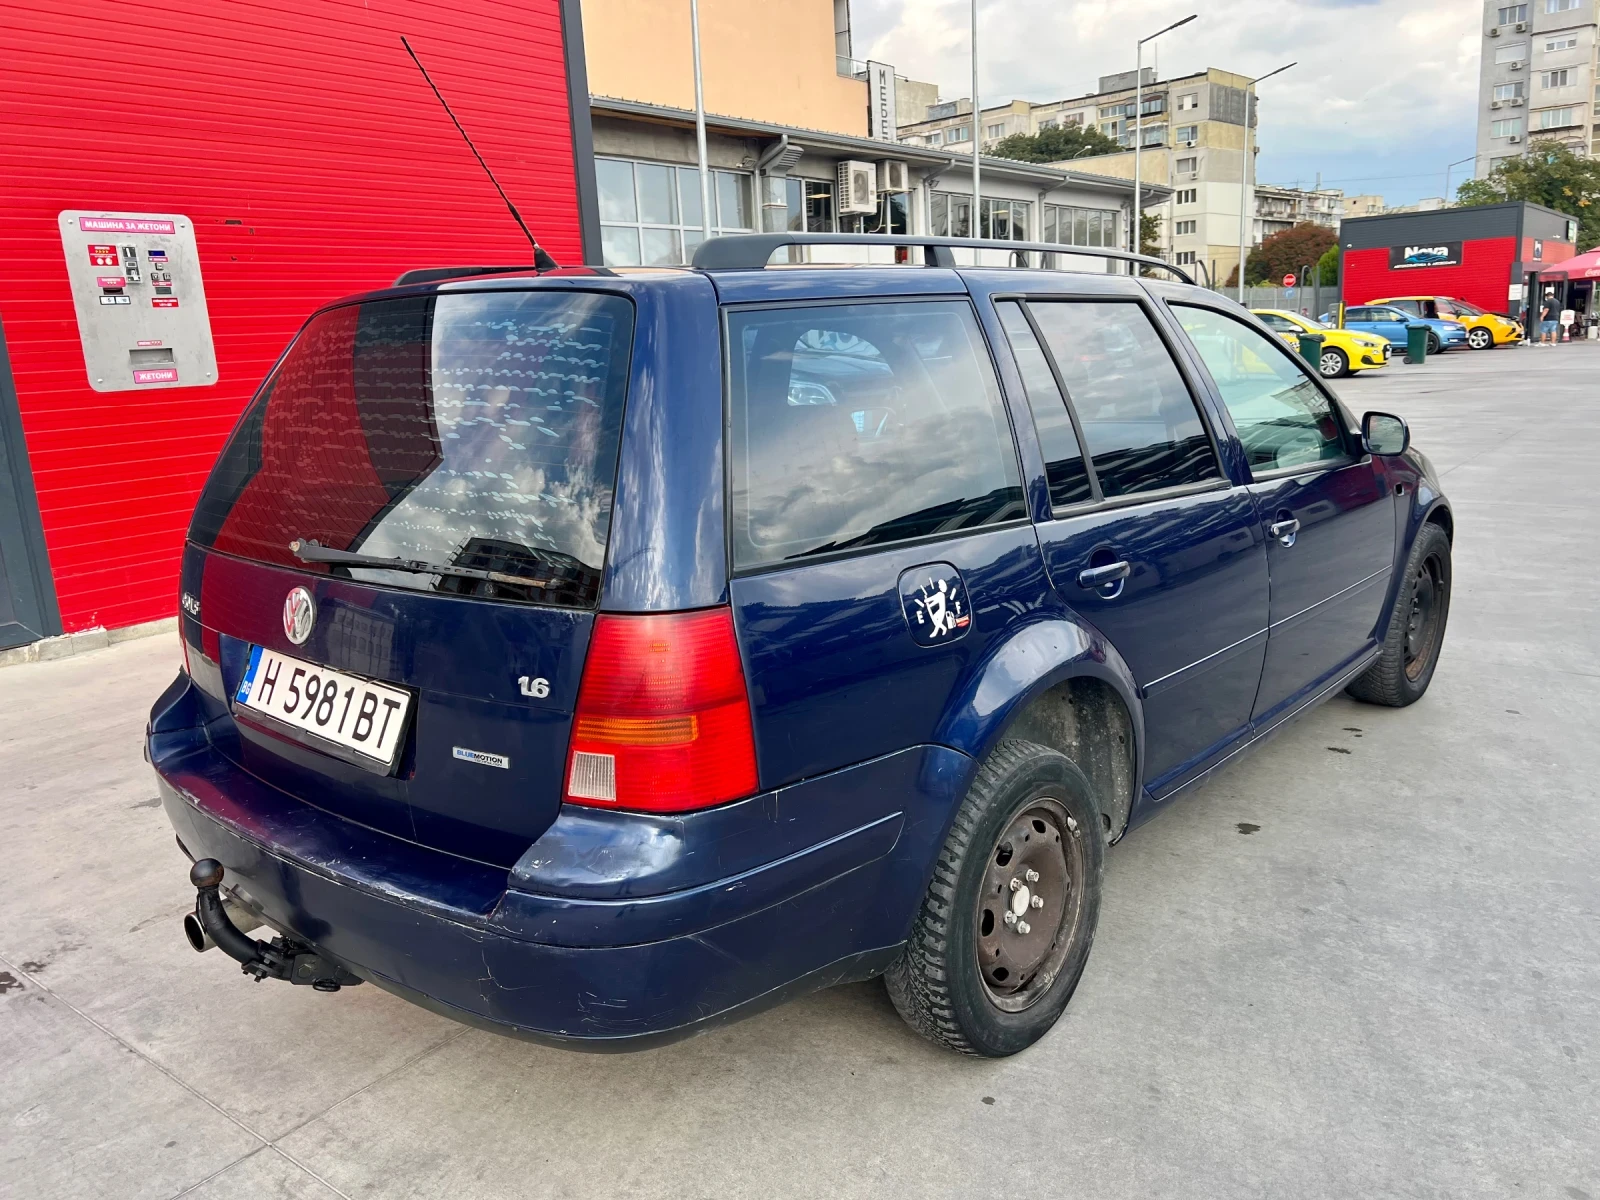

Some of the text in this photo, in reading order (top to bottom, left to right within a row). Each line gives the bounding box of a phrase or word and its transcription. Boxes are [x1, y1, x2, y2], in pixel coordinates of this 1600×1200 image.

[879, 68, 889, 141] МЕБЕ
[84, 220, 171, 231] МАШИНА ЗА ЖЕТОНИ
[139, 371, 173, 381] ЖЕТОНИ
[241, 680, 251, 695] BG
[257, 658, 402, 749] H 5981BT
[456, 749, 503, 764] BLUEMOTION
